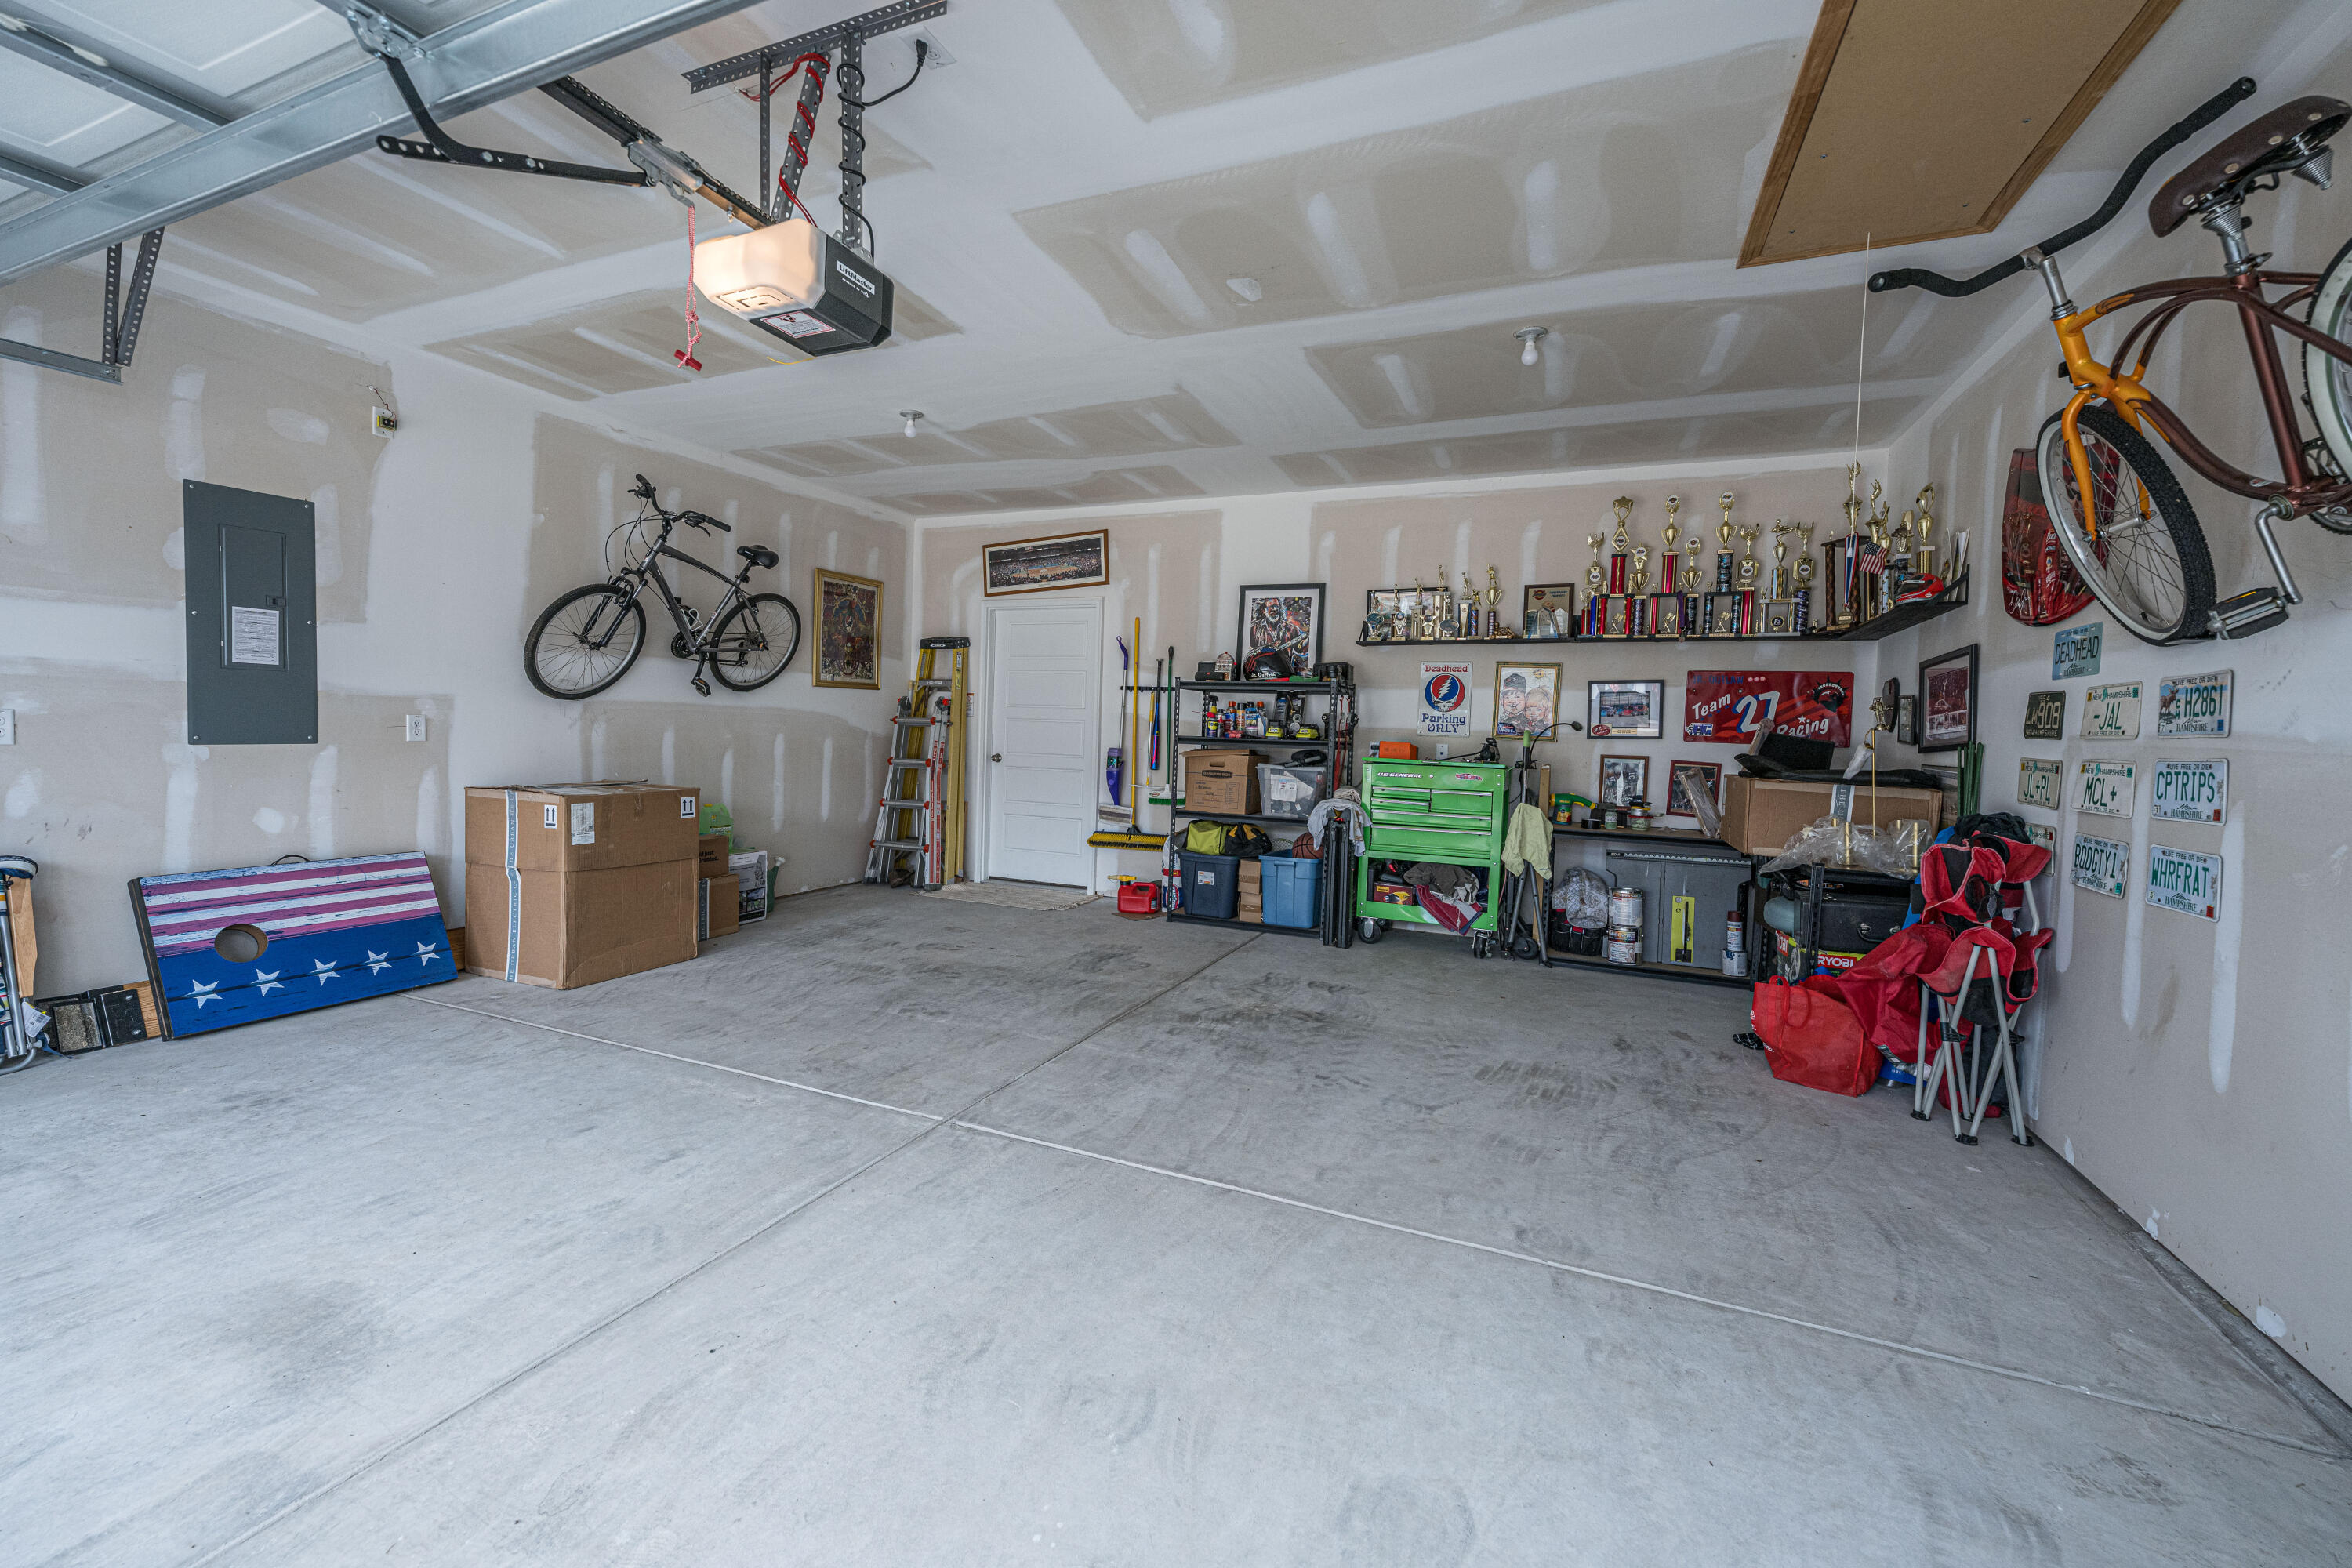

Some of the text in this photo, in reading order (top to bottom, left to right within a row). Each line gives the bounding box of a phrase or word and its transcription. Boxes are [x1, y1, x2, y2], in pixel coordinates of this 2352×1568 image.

[840, 264, 872, 291] LiftMaster
[2055, 636, 2099, 665] DEADHEAD
[1709, 675, 1744, 684] OUTLAW
[2107, 690, 2132, 699] HAMPSHIRE
[2184, 684, 2223, 717] H2861
[1692, 694, 1730, 720] Team
[1732, 691, 1780, 733] 27
[1422, 713, 1466, 725] Parking
[1428, 723, 1459, 733] ONLY
[2176, 723, 2208, 732] HAMPSHIRE
[2100, 768, 2125, 777] HAMPSHIRE
[2084, 777, 2117, 807] MCL+
[2156, 771, 2216, 803] CPTRIPS
[2171, 809, 2203, 819] HAMPSHIRE
[2151, 857, 2209, 898] WHRFRAT
[2165, 896, 2197, 912] HAMPSHIRE
[1818, 956, 1853, 968] RYOBI
